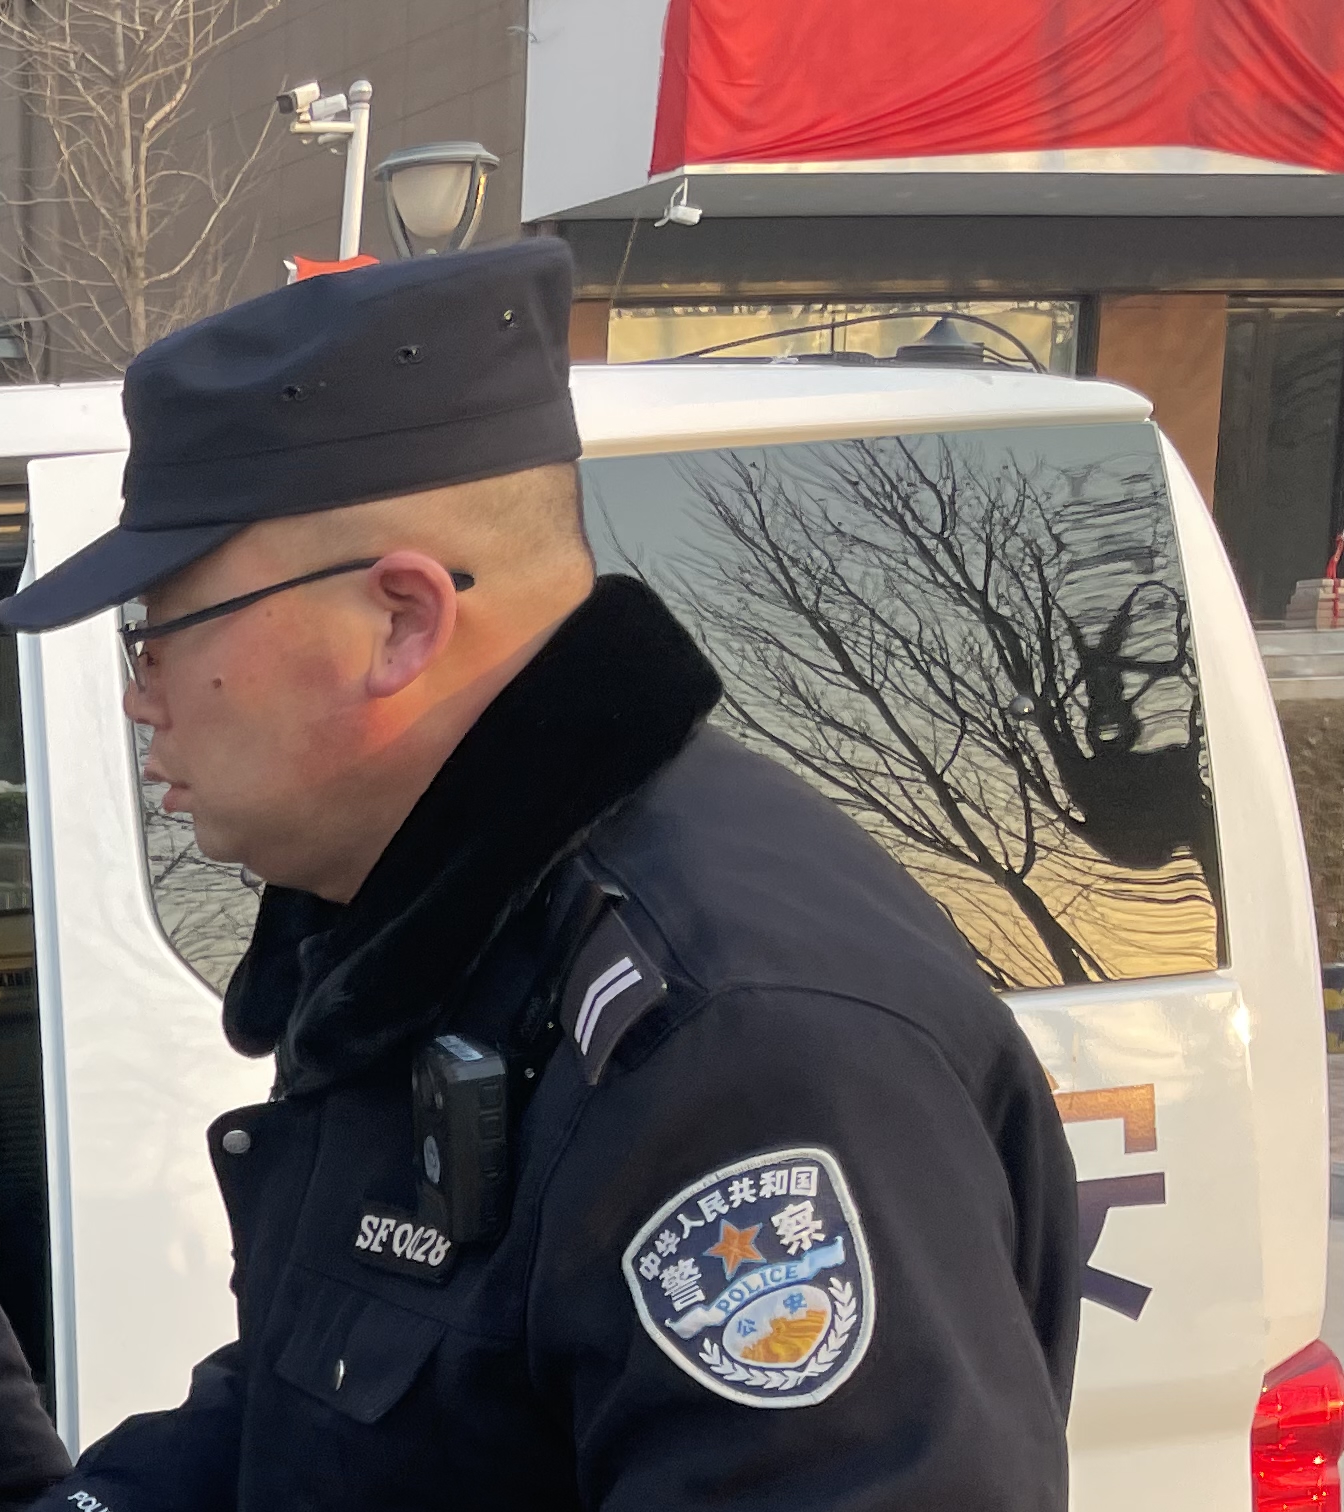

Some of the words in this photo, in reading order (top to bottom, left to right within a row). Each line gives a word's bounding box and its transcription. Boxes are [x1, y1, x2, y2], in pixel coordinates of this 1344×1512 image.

[638, 1165, 819, 1282] 中华人民共和国
[714, 1263, 801, 1315] POLICE
